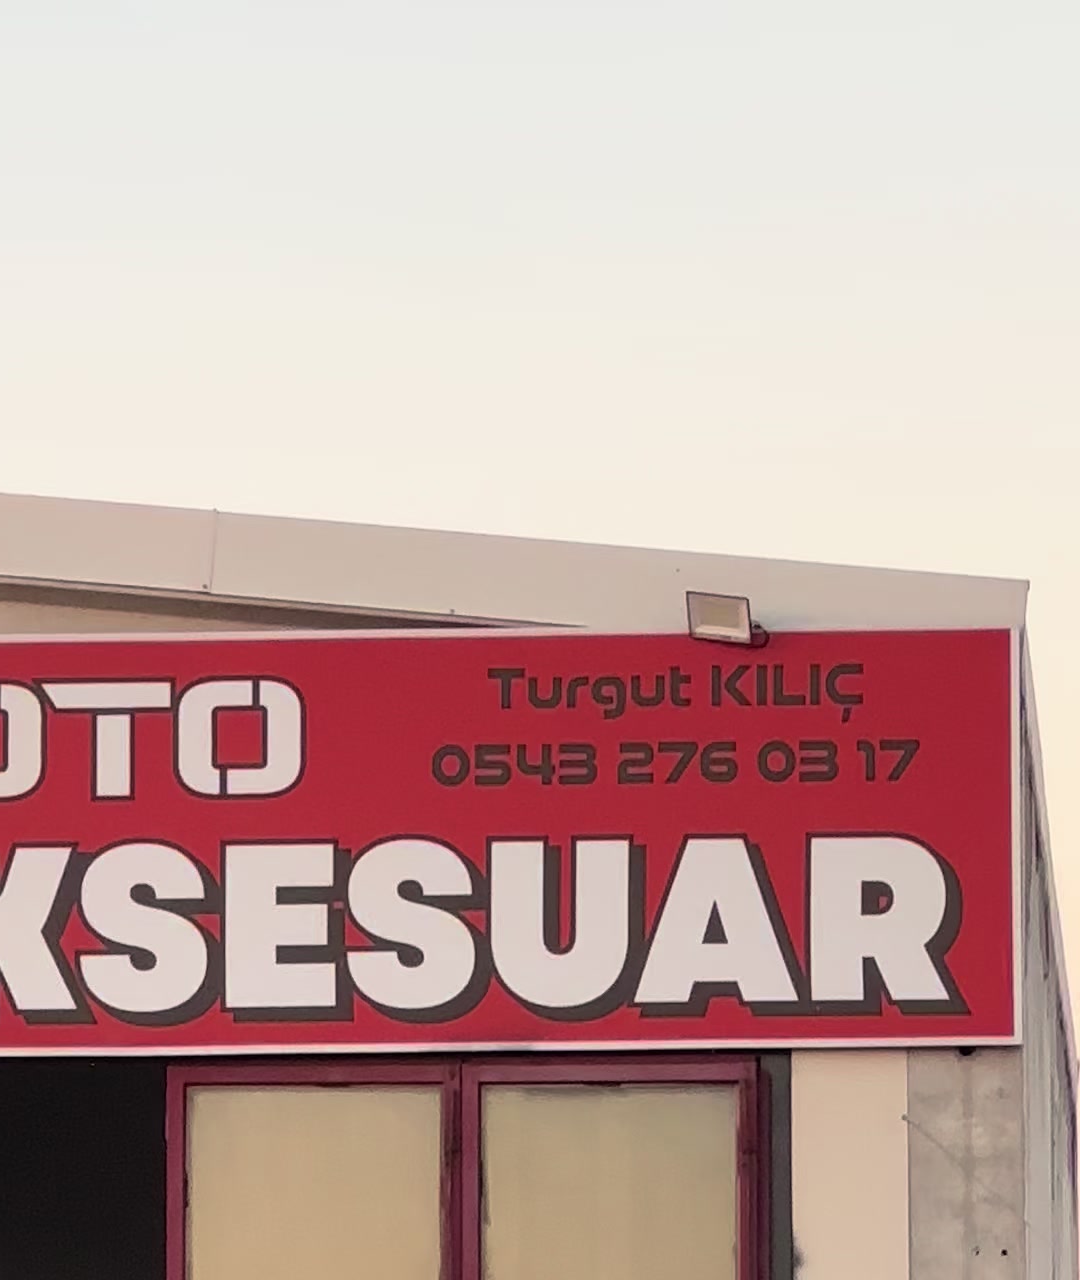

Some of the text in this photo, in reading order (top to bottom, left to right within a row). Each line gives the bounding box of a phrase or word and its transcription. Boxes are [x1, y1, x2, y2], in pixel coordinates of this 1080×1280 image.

[487, 663, 864, 723] Turgut KILIÇ
[432, 738, 920, 786] 0543 276 03 17
